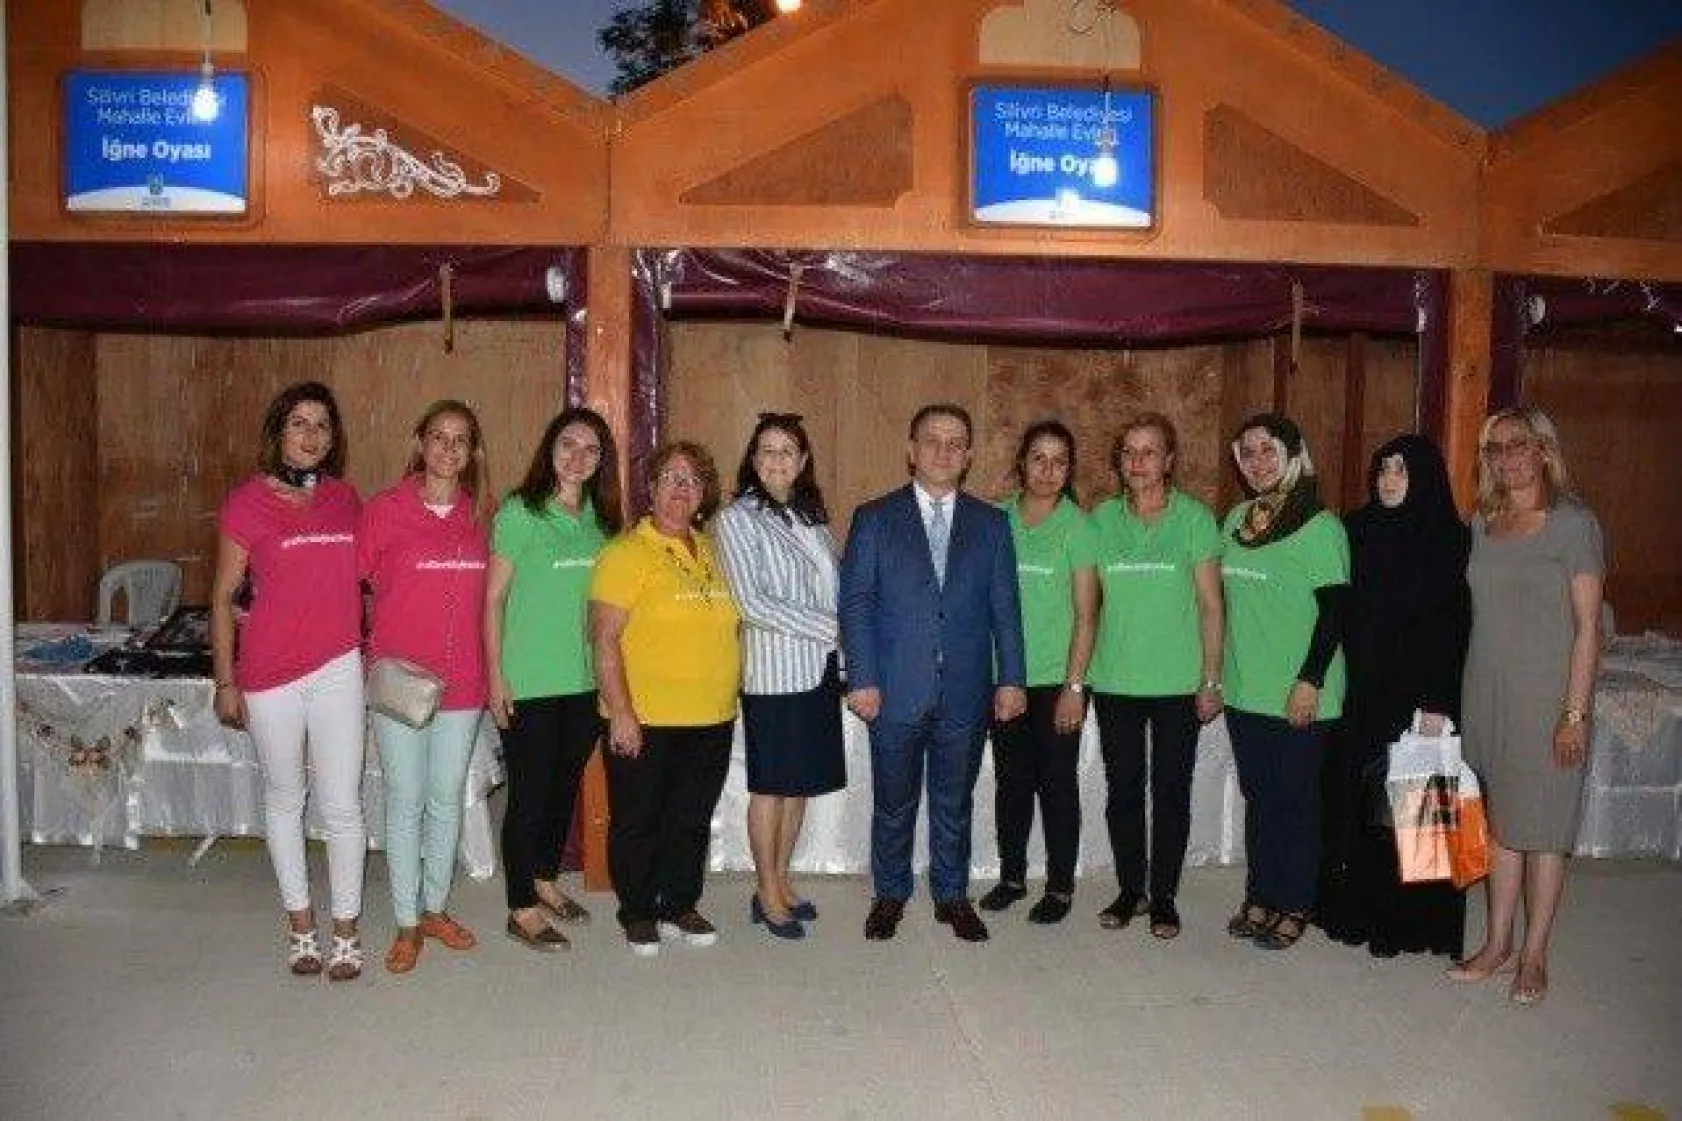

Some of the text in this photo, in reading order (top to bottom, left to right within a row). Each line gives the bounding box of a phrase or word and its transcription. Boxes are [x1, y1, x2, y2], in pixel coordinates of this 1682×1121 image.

[102, 136, 212, 163] İğne Oyası
[1010, 149, 1116, 176] İğne Oya
